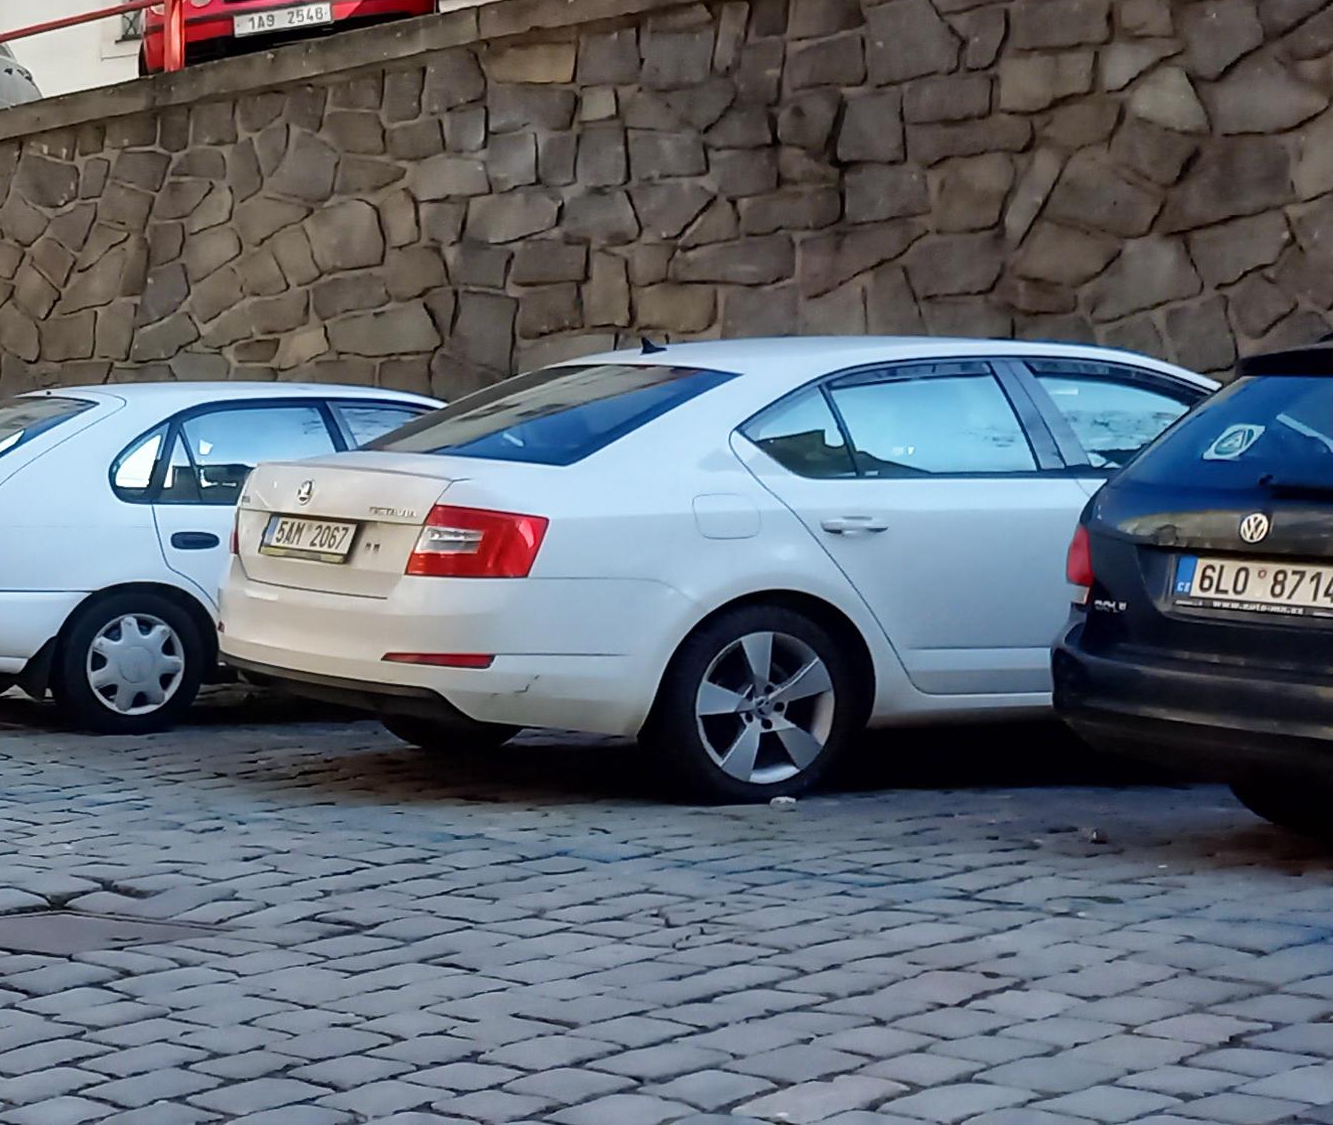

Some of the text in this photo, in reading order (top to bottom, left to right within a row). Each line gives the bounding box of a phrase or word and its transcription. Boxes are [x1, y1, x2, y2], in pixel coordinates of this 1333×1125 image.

[248, 14, 275, 30] 1A9
[276, 521, 305, 545] 5AM
[310, 525, 349, 550] 2067
